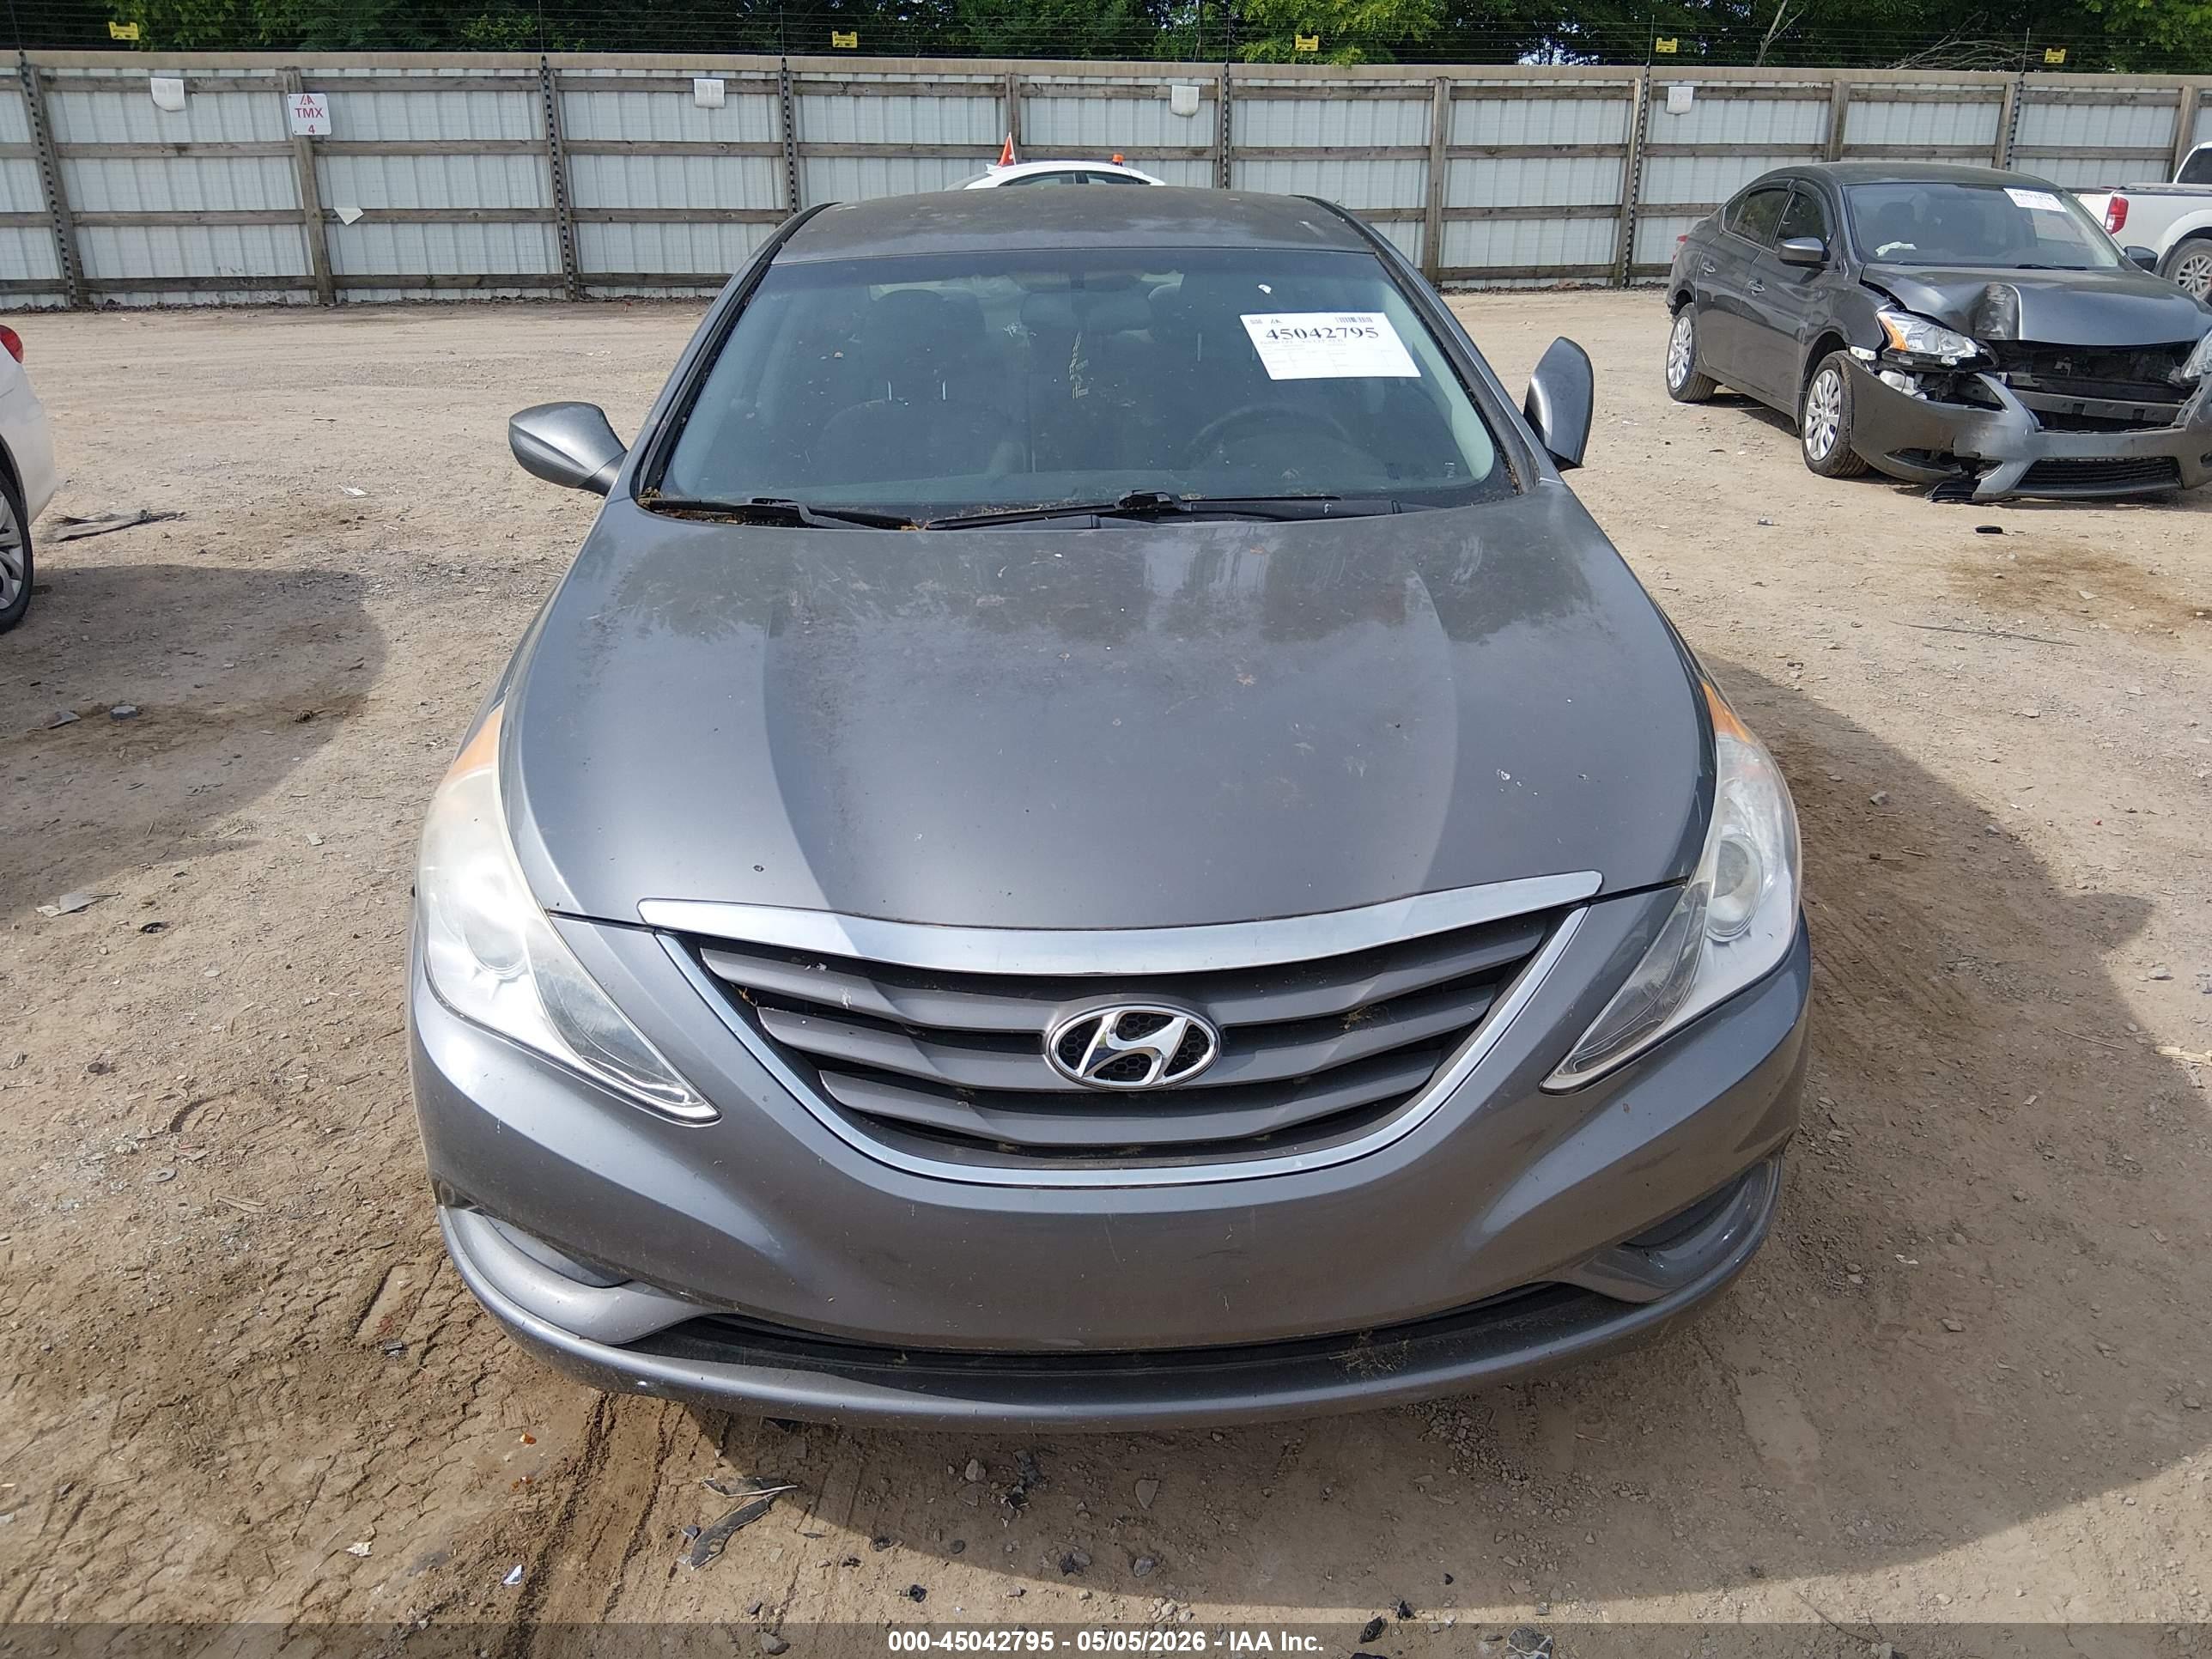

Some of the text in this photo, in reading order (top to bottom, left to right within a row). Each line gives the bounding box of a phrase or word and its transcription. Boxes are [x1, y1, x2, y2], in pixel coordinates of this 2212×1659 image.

[295, 107, 324, 118] TMX
[308, 124, 316, 135] 4
[1265, 326, 1379, 340] 45042795
